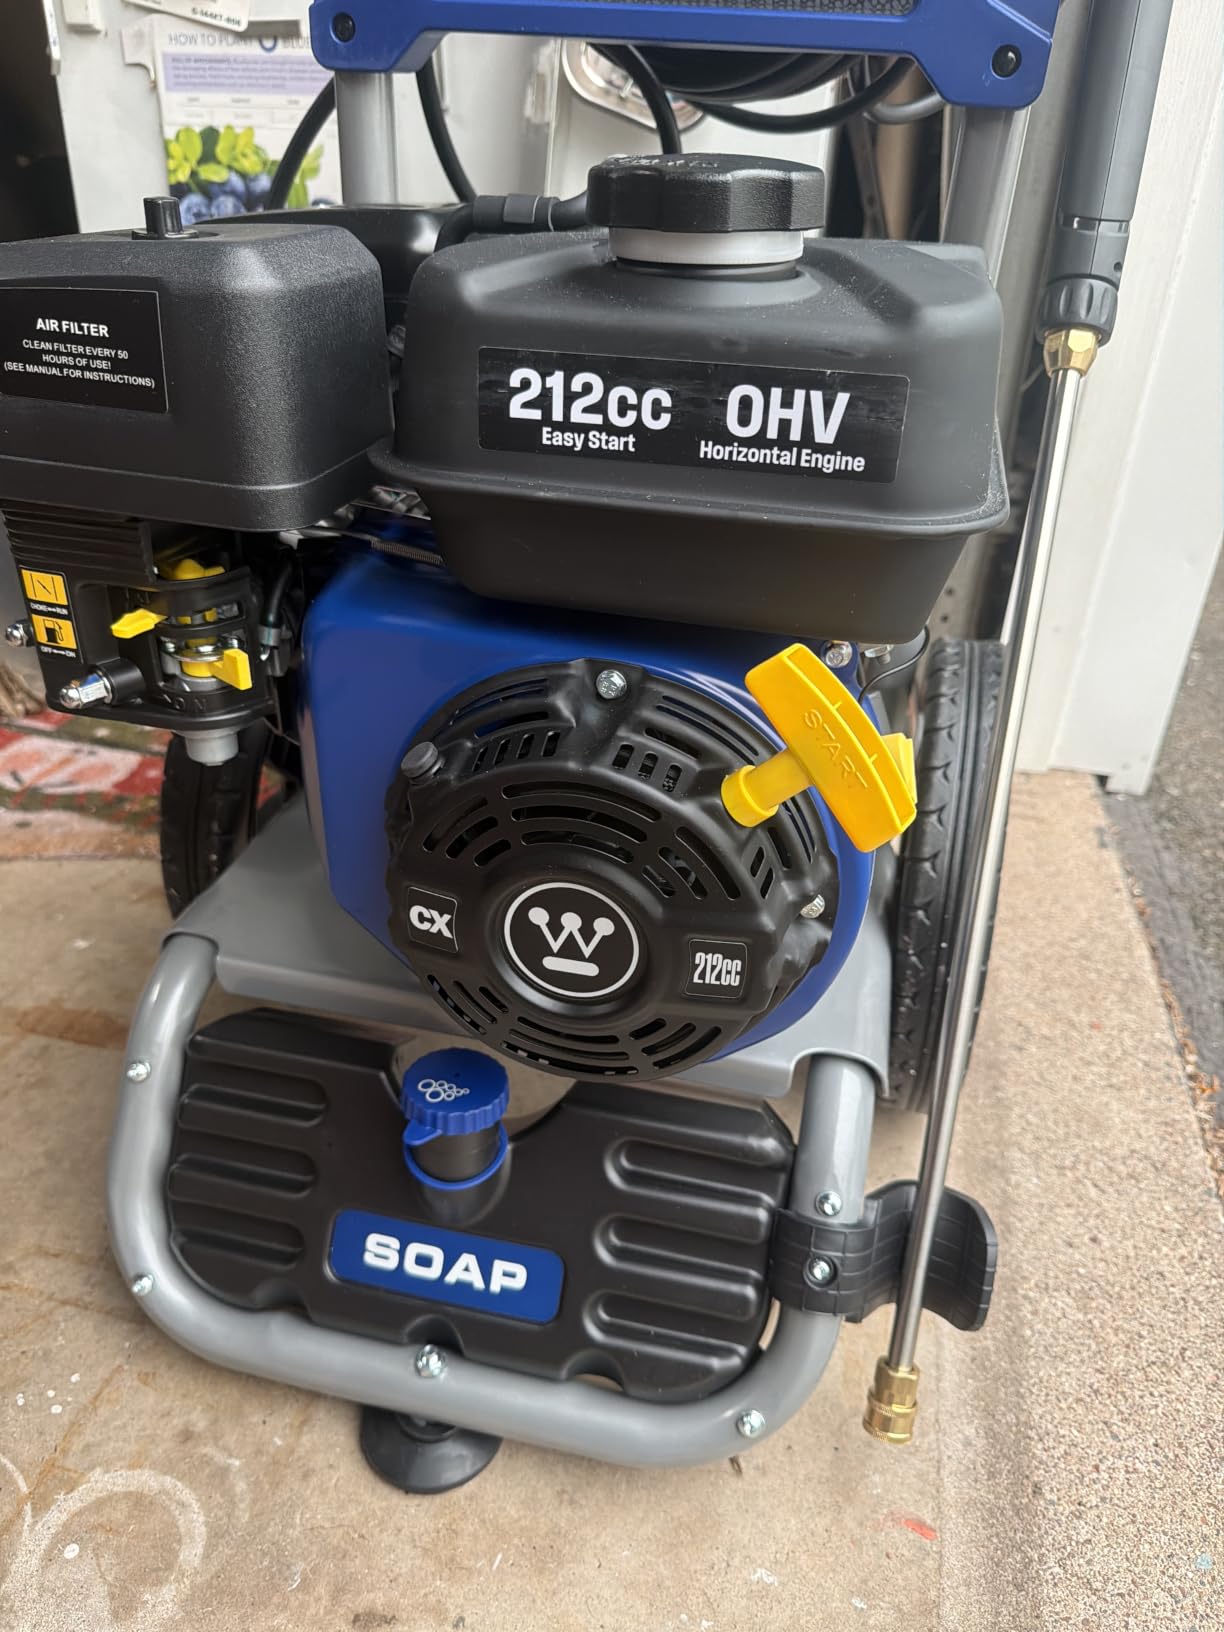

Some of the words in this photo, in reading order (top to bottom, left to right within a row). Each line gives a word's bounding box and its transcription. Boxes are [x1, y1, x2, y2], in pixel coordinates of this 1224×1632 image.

[168, 32, 197, 46] HOW
[201, 32, 217, 47] TO
[36, 318, 59, 332] AIR
[61, 320, 110, 337] FILTER
[22, 339, 52, 351] CLEAN
[54, 342, 85, 355] FILTER
[85, 346, 117, 358] EVERY
[117, 350, 129, 360] 50
[42, 354, 75, 366] HOURS
[75, 357, 88, 367] OF
[90, 359, 111, 370] USE!
[4, 361, 25, 372] (SEE
[26, 363, 63, 376] MANUAL
[63, 369, 82, 379] FOR
[83, 371, 156, 389] INSTRUCTIONS)
[509, 367, 672, 430] 212cc
[726, 384, 850, 444] OHV
[541, 426, 585, 451] Easy
[588, 430, 636, 452] Start
[699, 440, 797, 466] Horizontal
[799, 449, 866, 473] Engine
[804, 708, 869, 790] START
[409, 905, 453, 939] CX
[363, 1232, 528, 1295] SOAP
